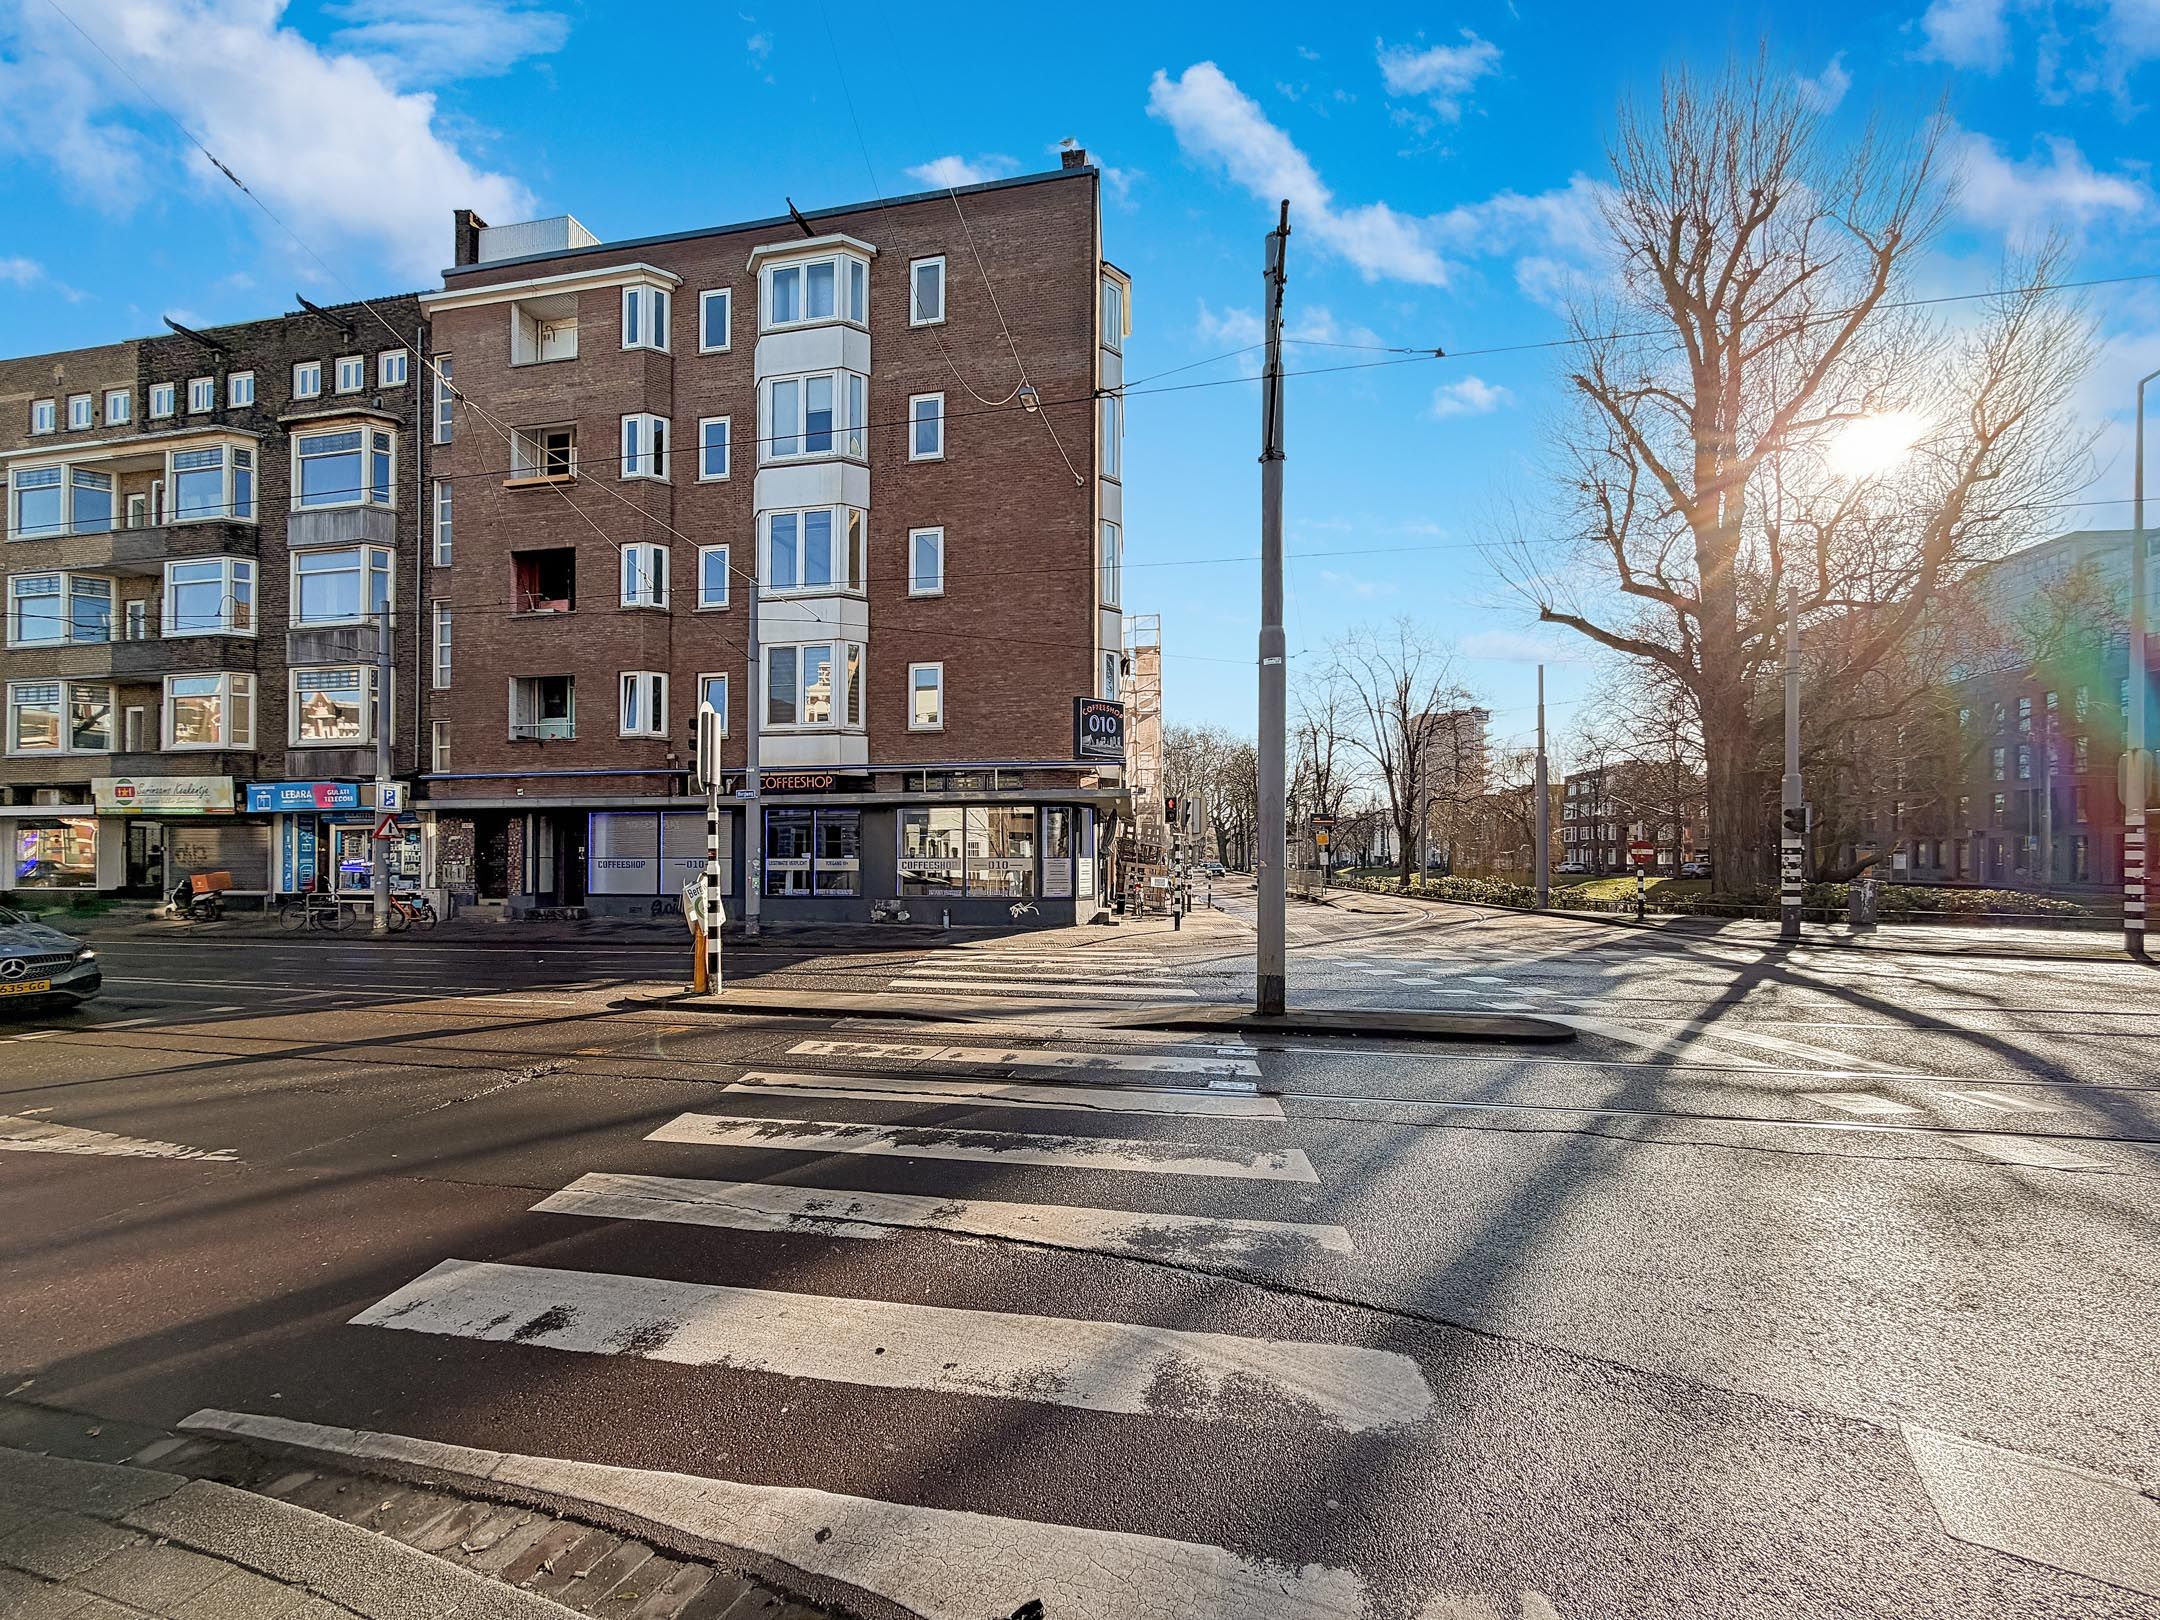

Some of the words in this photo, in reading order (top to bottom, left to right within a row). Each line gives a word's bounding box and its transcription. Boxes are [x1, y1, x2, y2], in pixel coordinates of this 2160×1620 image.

[1082, 703, 1124, 719] COFFEESHOP
[1089, 714, 1117, 734] 010
[280, 789, 313, 799] LEBARA
[597, 860, 646, 869] COFFEESHOP
[686, 860, 704, 869] 010
[988, 860, 1009, 869] 010
